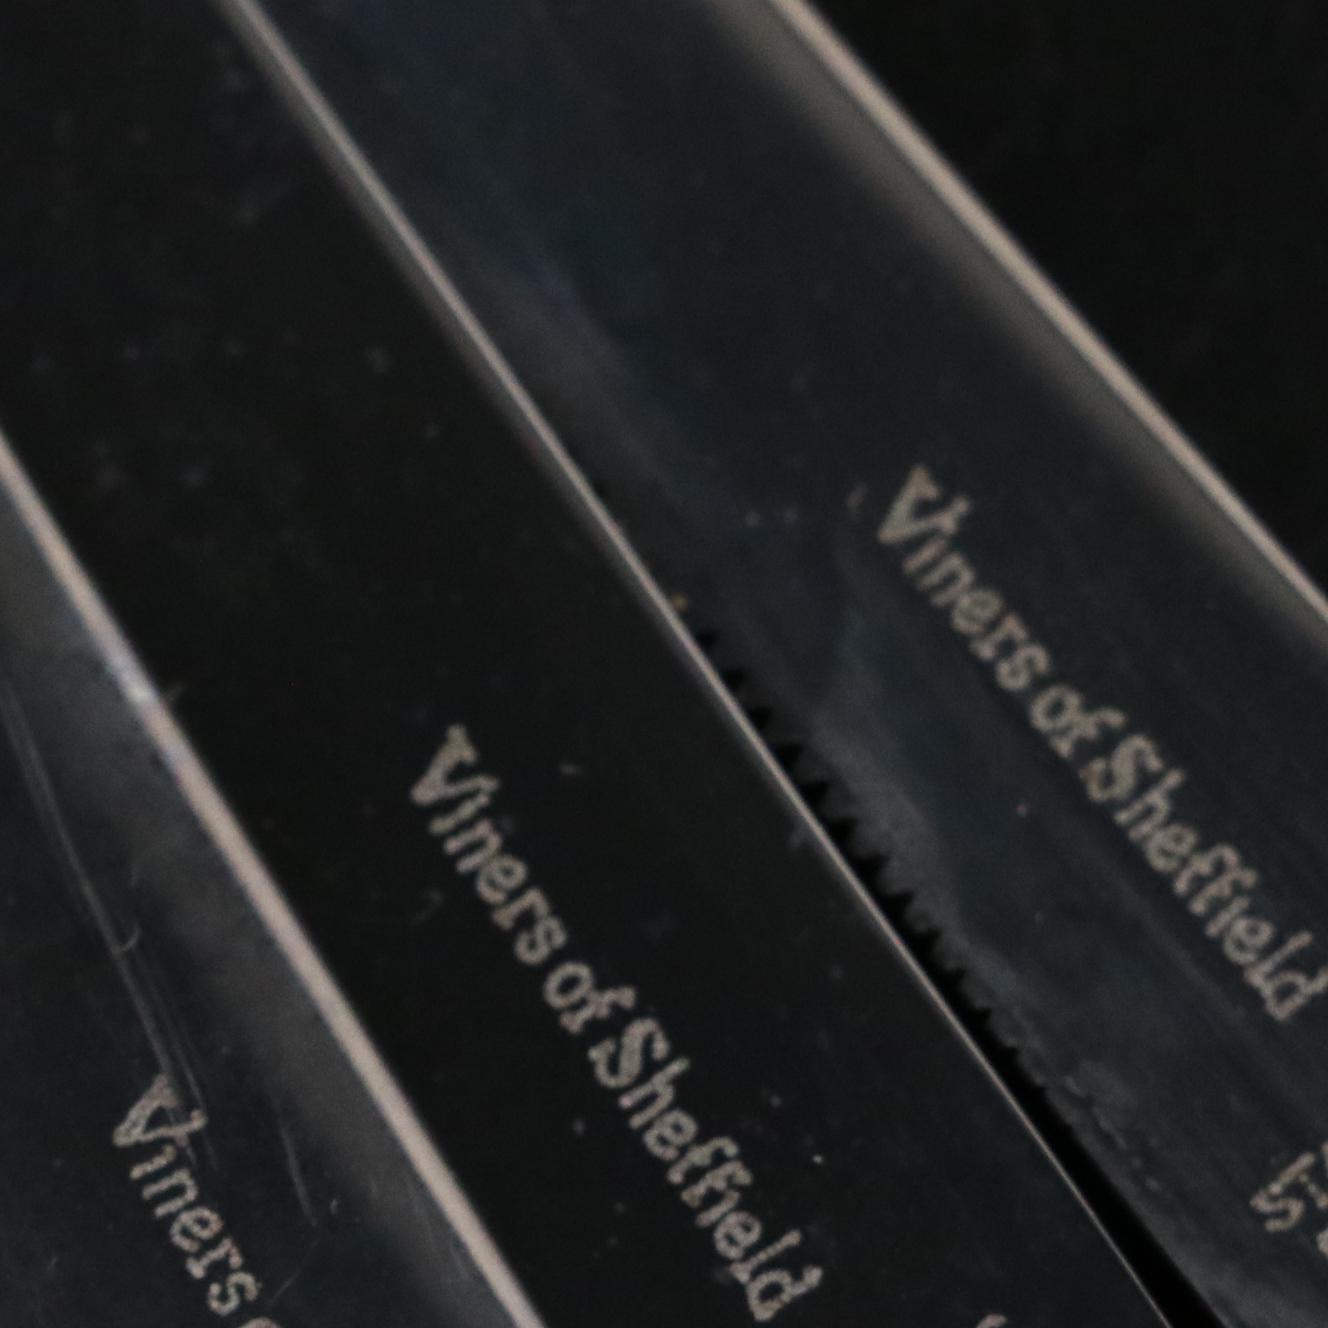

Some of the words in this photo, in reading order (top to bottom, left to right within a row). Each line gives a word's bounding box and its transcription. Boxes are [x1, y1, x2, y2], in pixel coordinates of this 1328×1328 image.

[410, 724, 568, 965] Viners
[877, 465, 1050, 691] Viners
[1030, 681, 1127, 759] of
[1081, 733, 1328, 1022] Sheffield
[543, 962, 638, 1035] of
[112, 1073, 259, 1316] Viners
[589, 1018, 823, 1322] Sheffield
